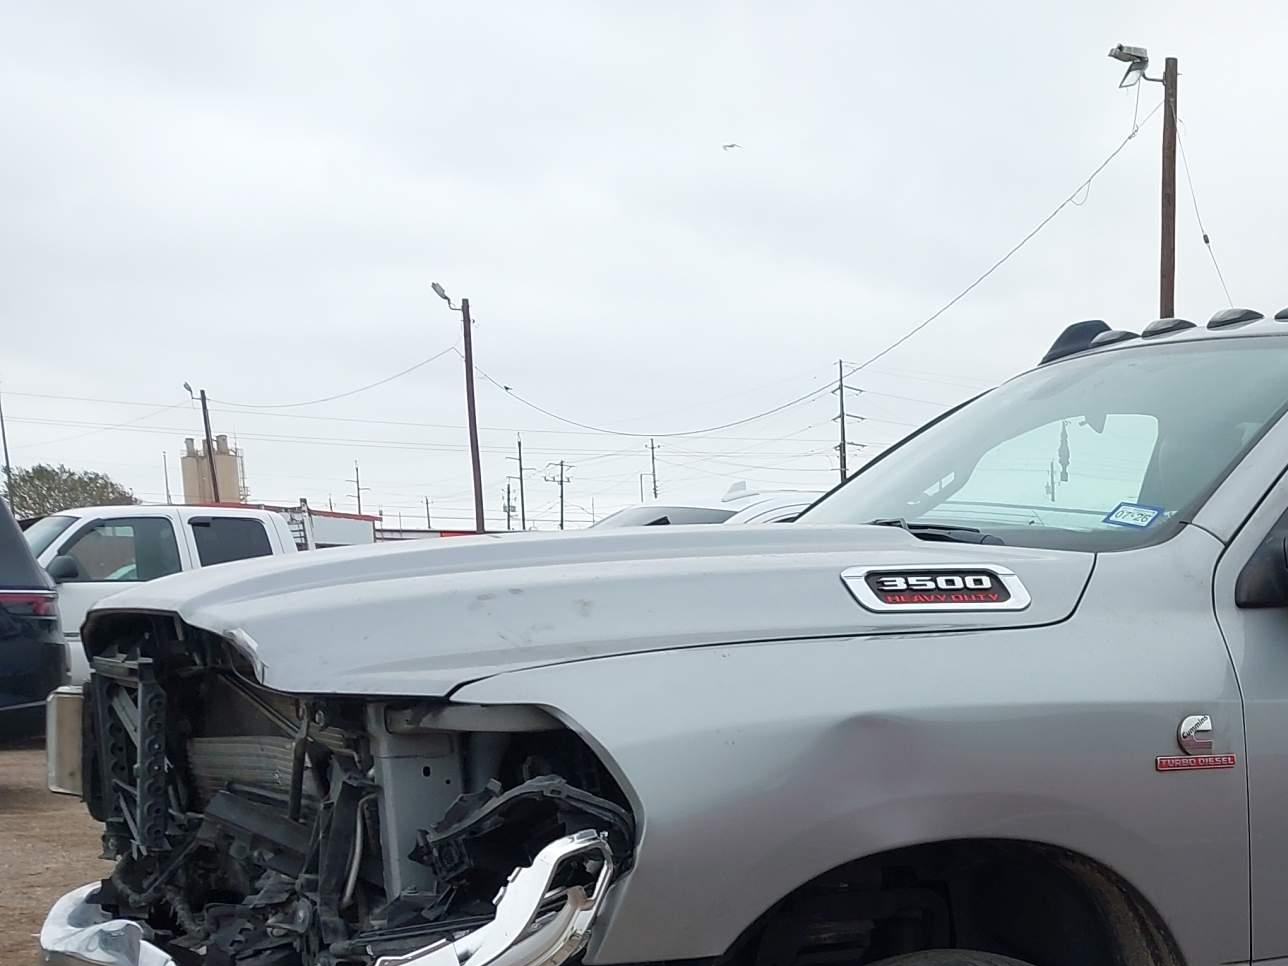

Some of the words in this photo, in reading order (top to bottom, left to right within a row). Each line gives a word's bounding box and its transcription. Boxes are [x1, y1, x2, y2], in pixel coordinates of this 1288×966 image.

[877, 575, 993, 590] 3500
[886, 594, 947, 603] HEAVY
[951, 593, 999, 602] DUTY
[1181, 715, 1208, 739] Cummins
[1160, 759, 1197, 768] TURBO
[1199, 756, 1234, 766] DIESEL
